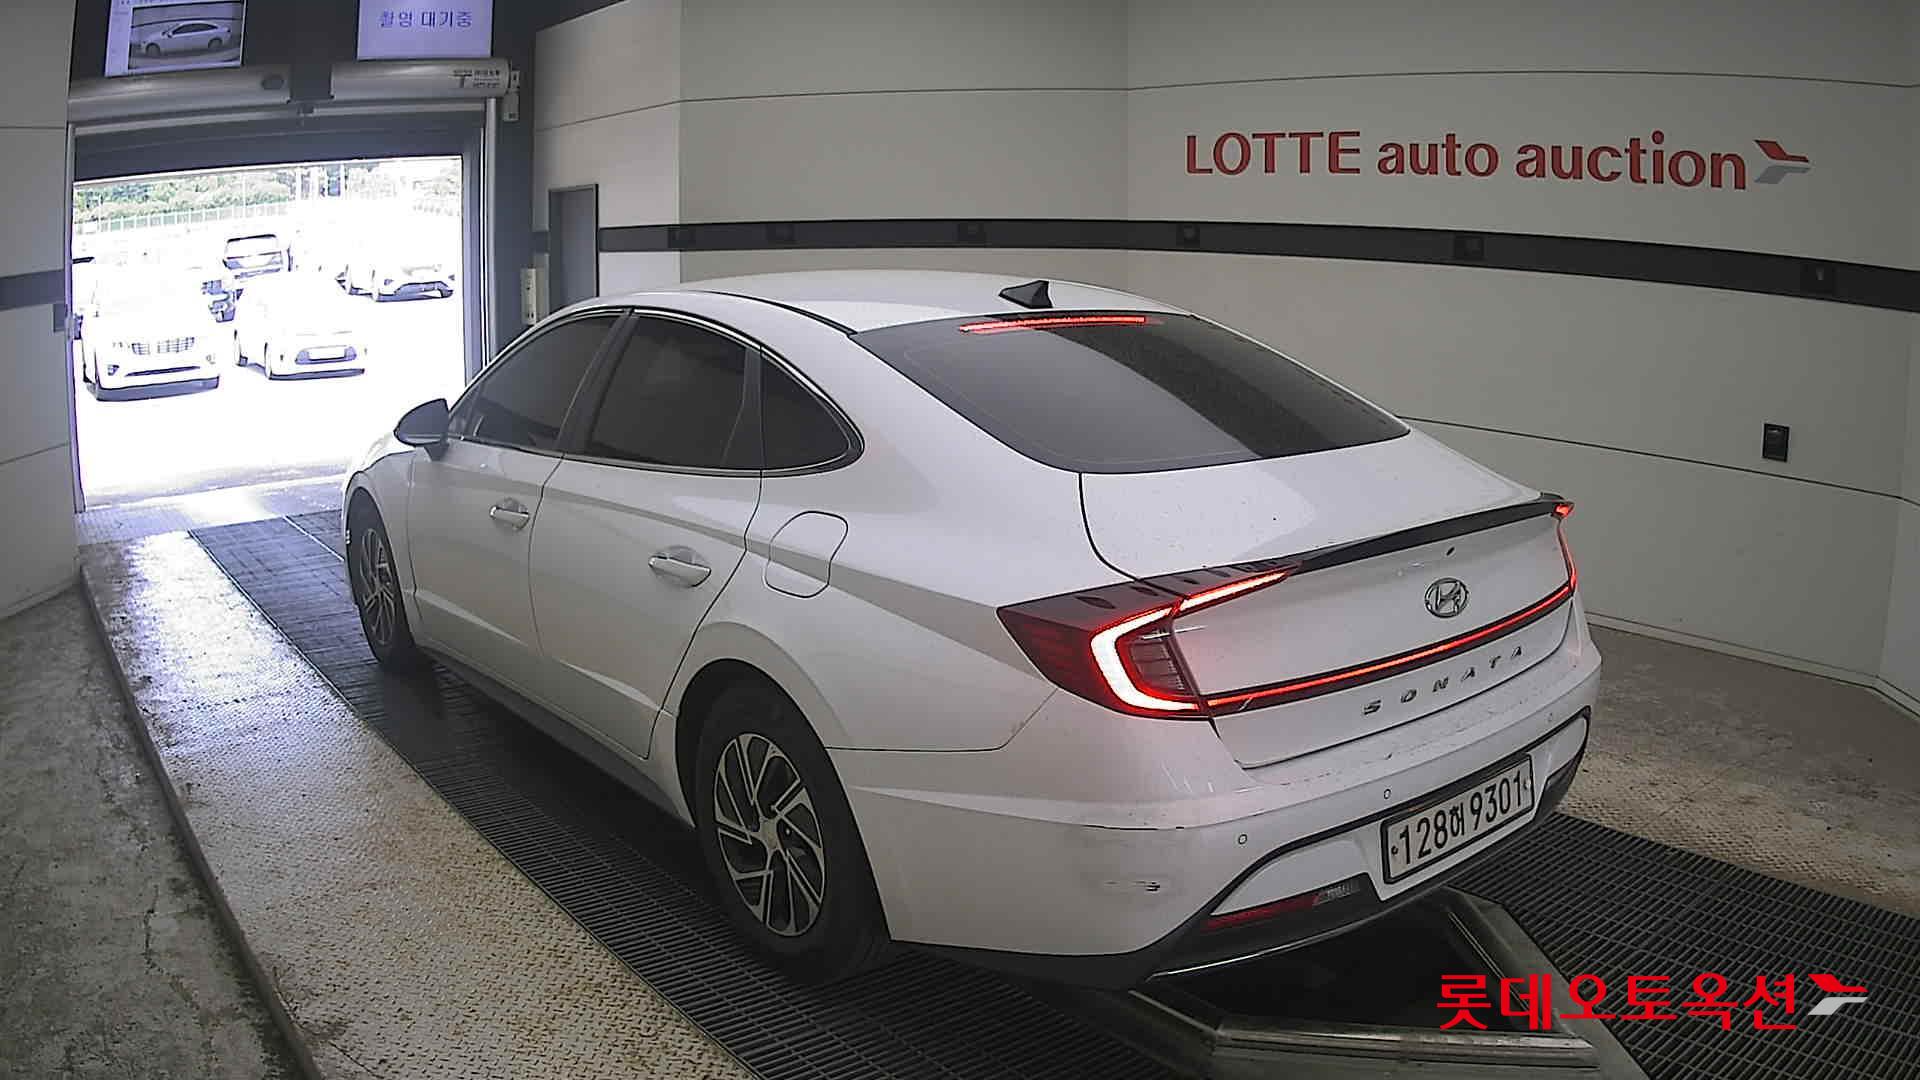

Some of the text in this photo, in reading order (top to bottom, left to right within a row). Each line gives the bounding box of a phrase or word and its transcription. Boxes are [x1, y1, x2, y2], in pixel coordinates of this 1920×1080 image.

[421, 10, 472, 28] 대기중
[1186, 130, 1747, 190] LOTTE auto auction
[1363, 645, 1523, 716] SONATA
